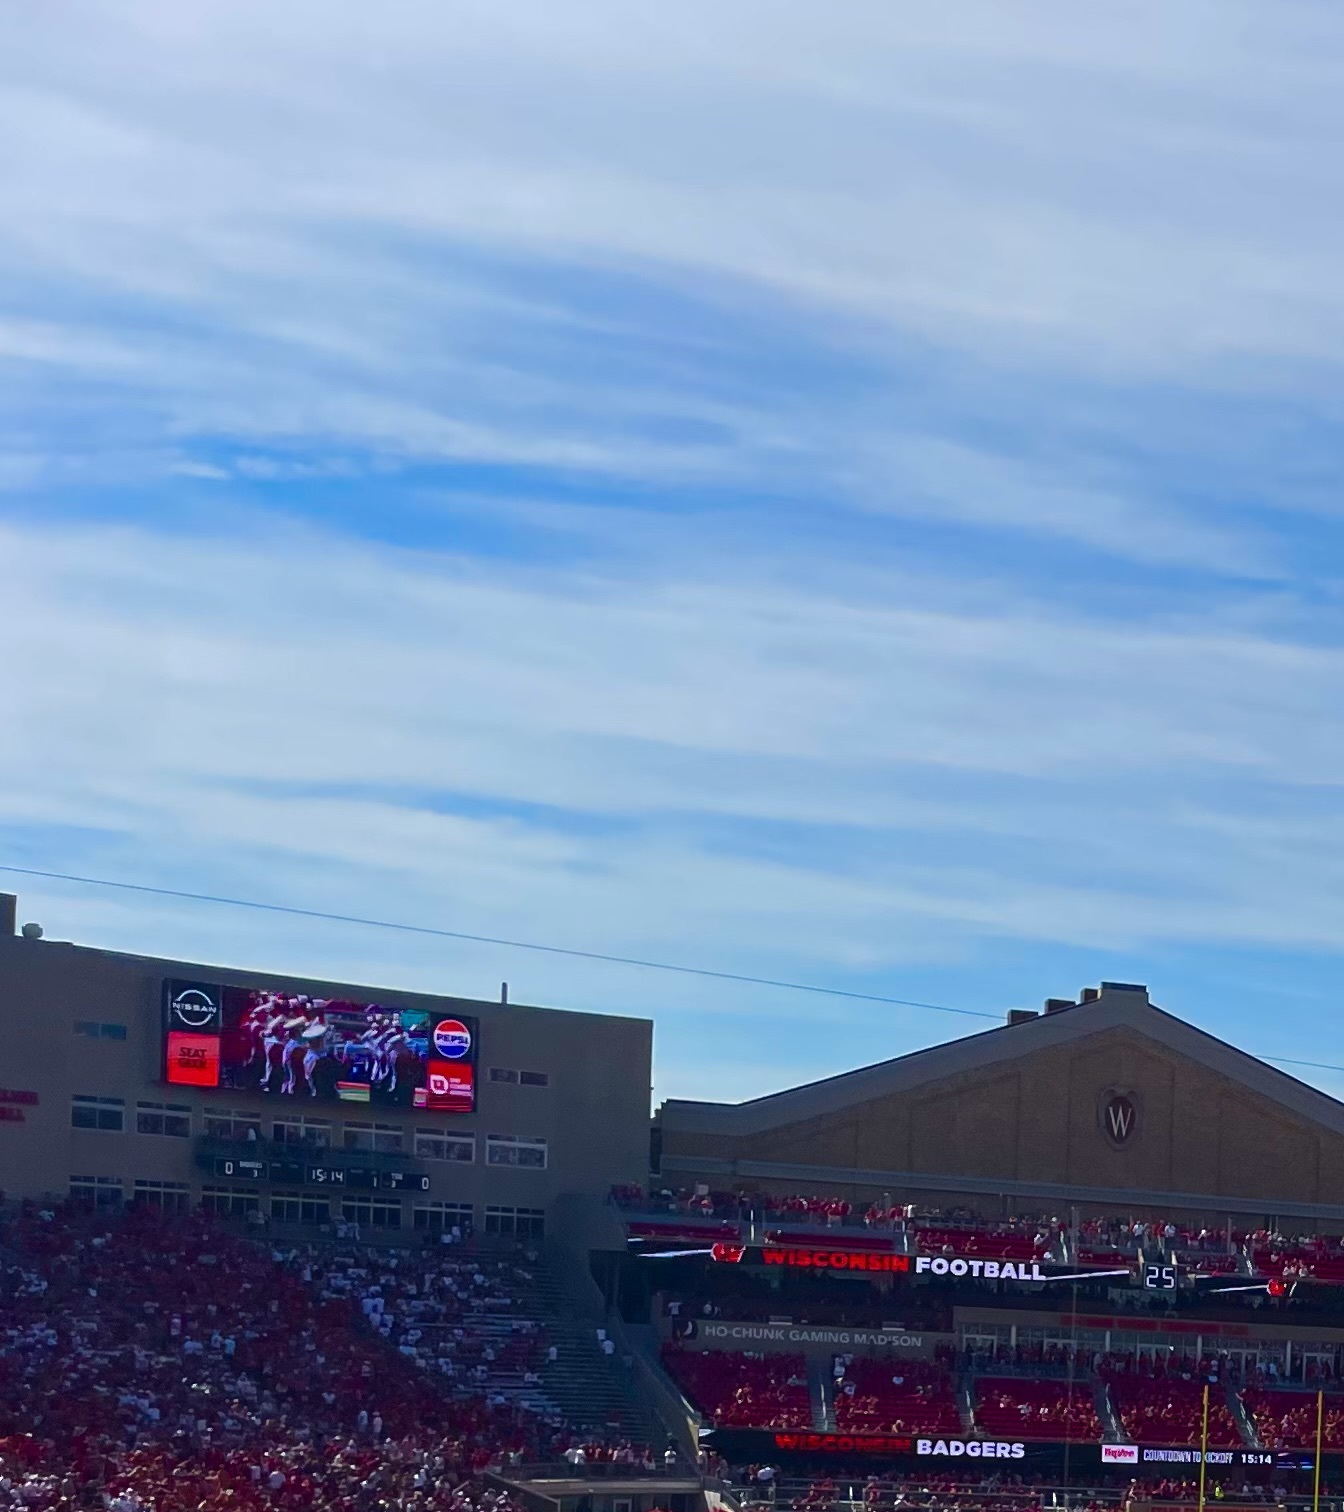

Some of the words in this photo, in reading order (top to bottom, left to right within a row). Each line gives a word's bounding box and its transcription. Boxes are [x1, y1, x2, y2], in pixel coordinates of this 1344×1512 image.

[172, 1001, 217, 1014] NISSAN
[436, 1033, 469, 1047] PEPSI
[179, 1047, 208, 1059] SEAT
[1109, 1105, 1132, 1137] W
[312, 1168, 344, 1183] 15:14
[762, 1248, 909, 1272] WISCONSIN
[915, 1256, 1048, 1281] FOOTBALL
[1145, 1266, 1175, 1290] 25
[788, 1330, 851, 1345] GAMING
[916, 1438, 1026, 1459] BADGERS
[1143, 1449, 1191, 1462] COUNTDOWN
[1241, 1453, 1272, 1465] 15:14
